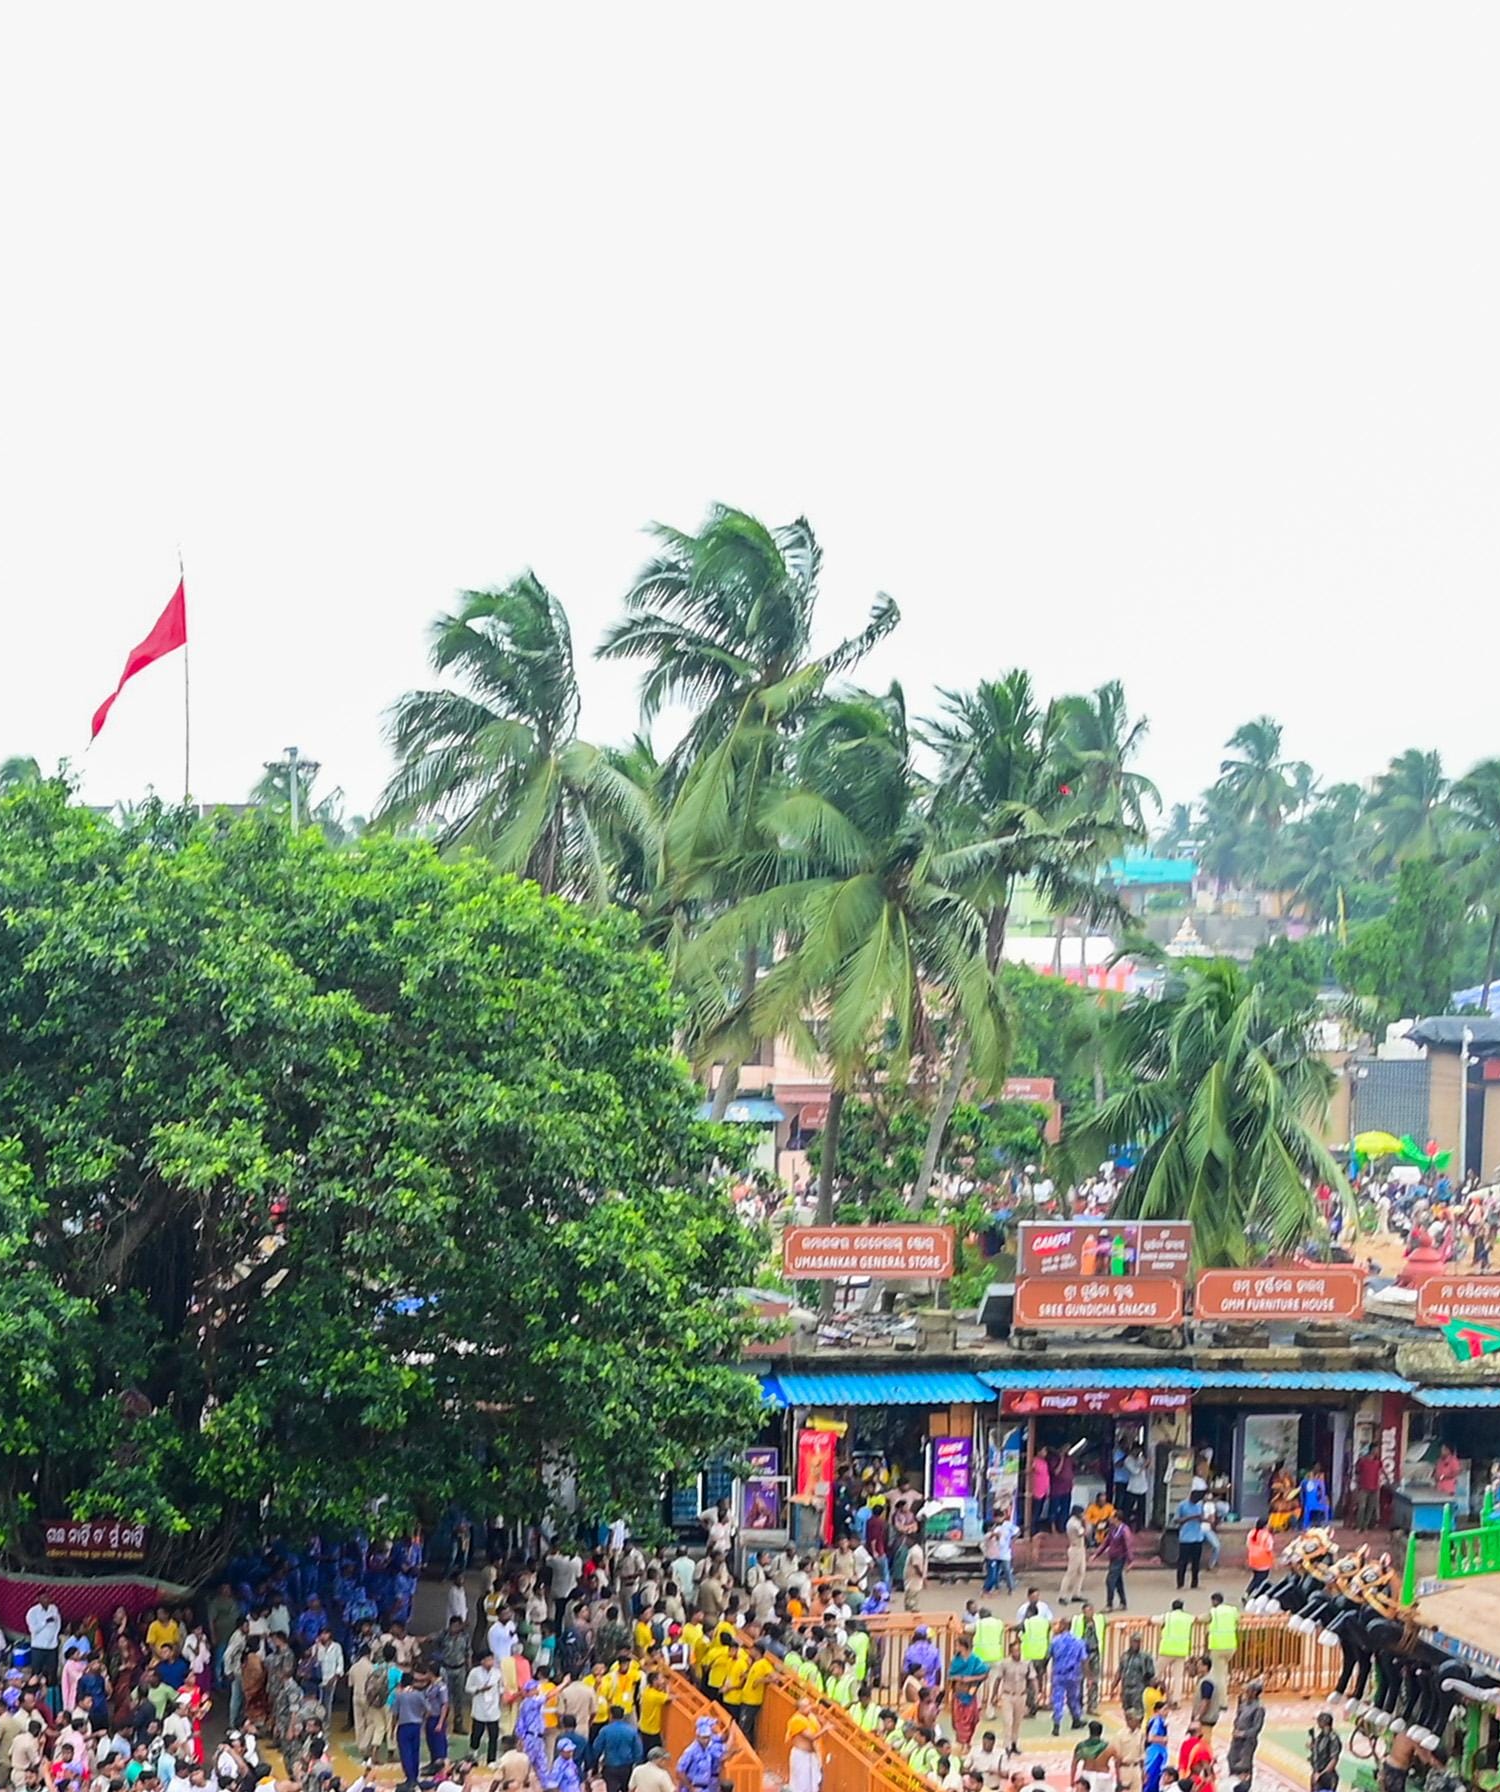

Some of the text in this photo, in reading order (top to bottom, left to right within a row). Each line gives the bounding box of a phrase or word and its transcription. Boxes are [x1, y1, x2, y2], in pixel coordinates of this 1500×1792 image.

[1032, 1231, 1073, 1251] CAMPA
[795, 1255, 941, 1269] UMASANKAR GENERAL STORE
[1038, 1302, 1157, 1317] SREE GUNDICHA SNACKS
[1220, 1298, 1335, 1311] OMM FURNITURE HOUSE
